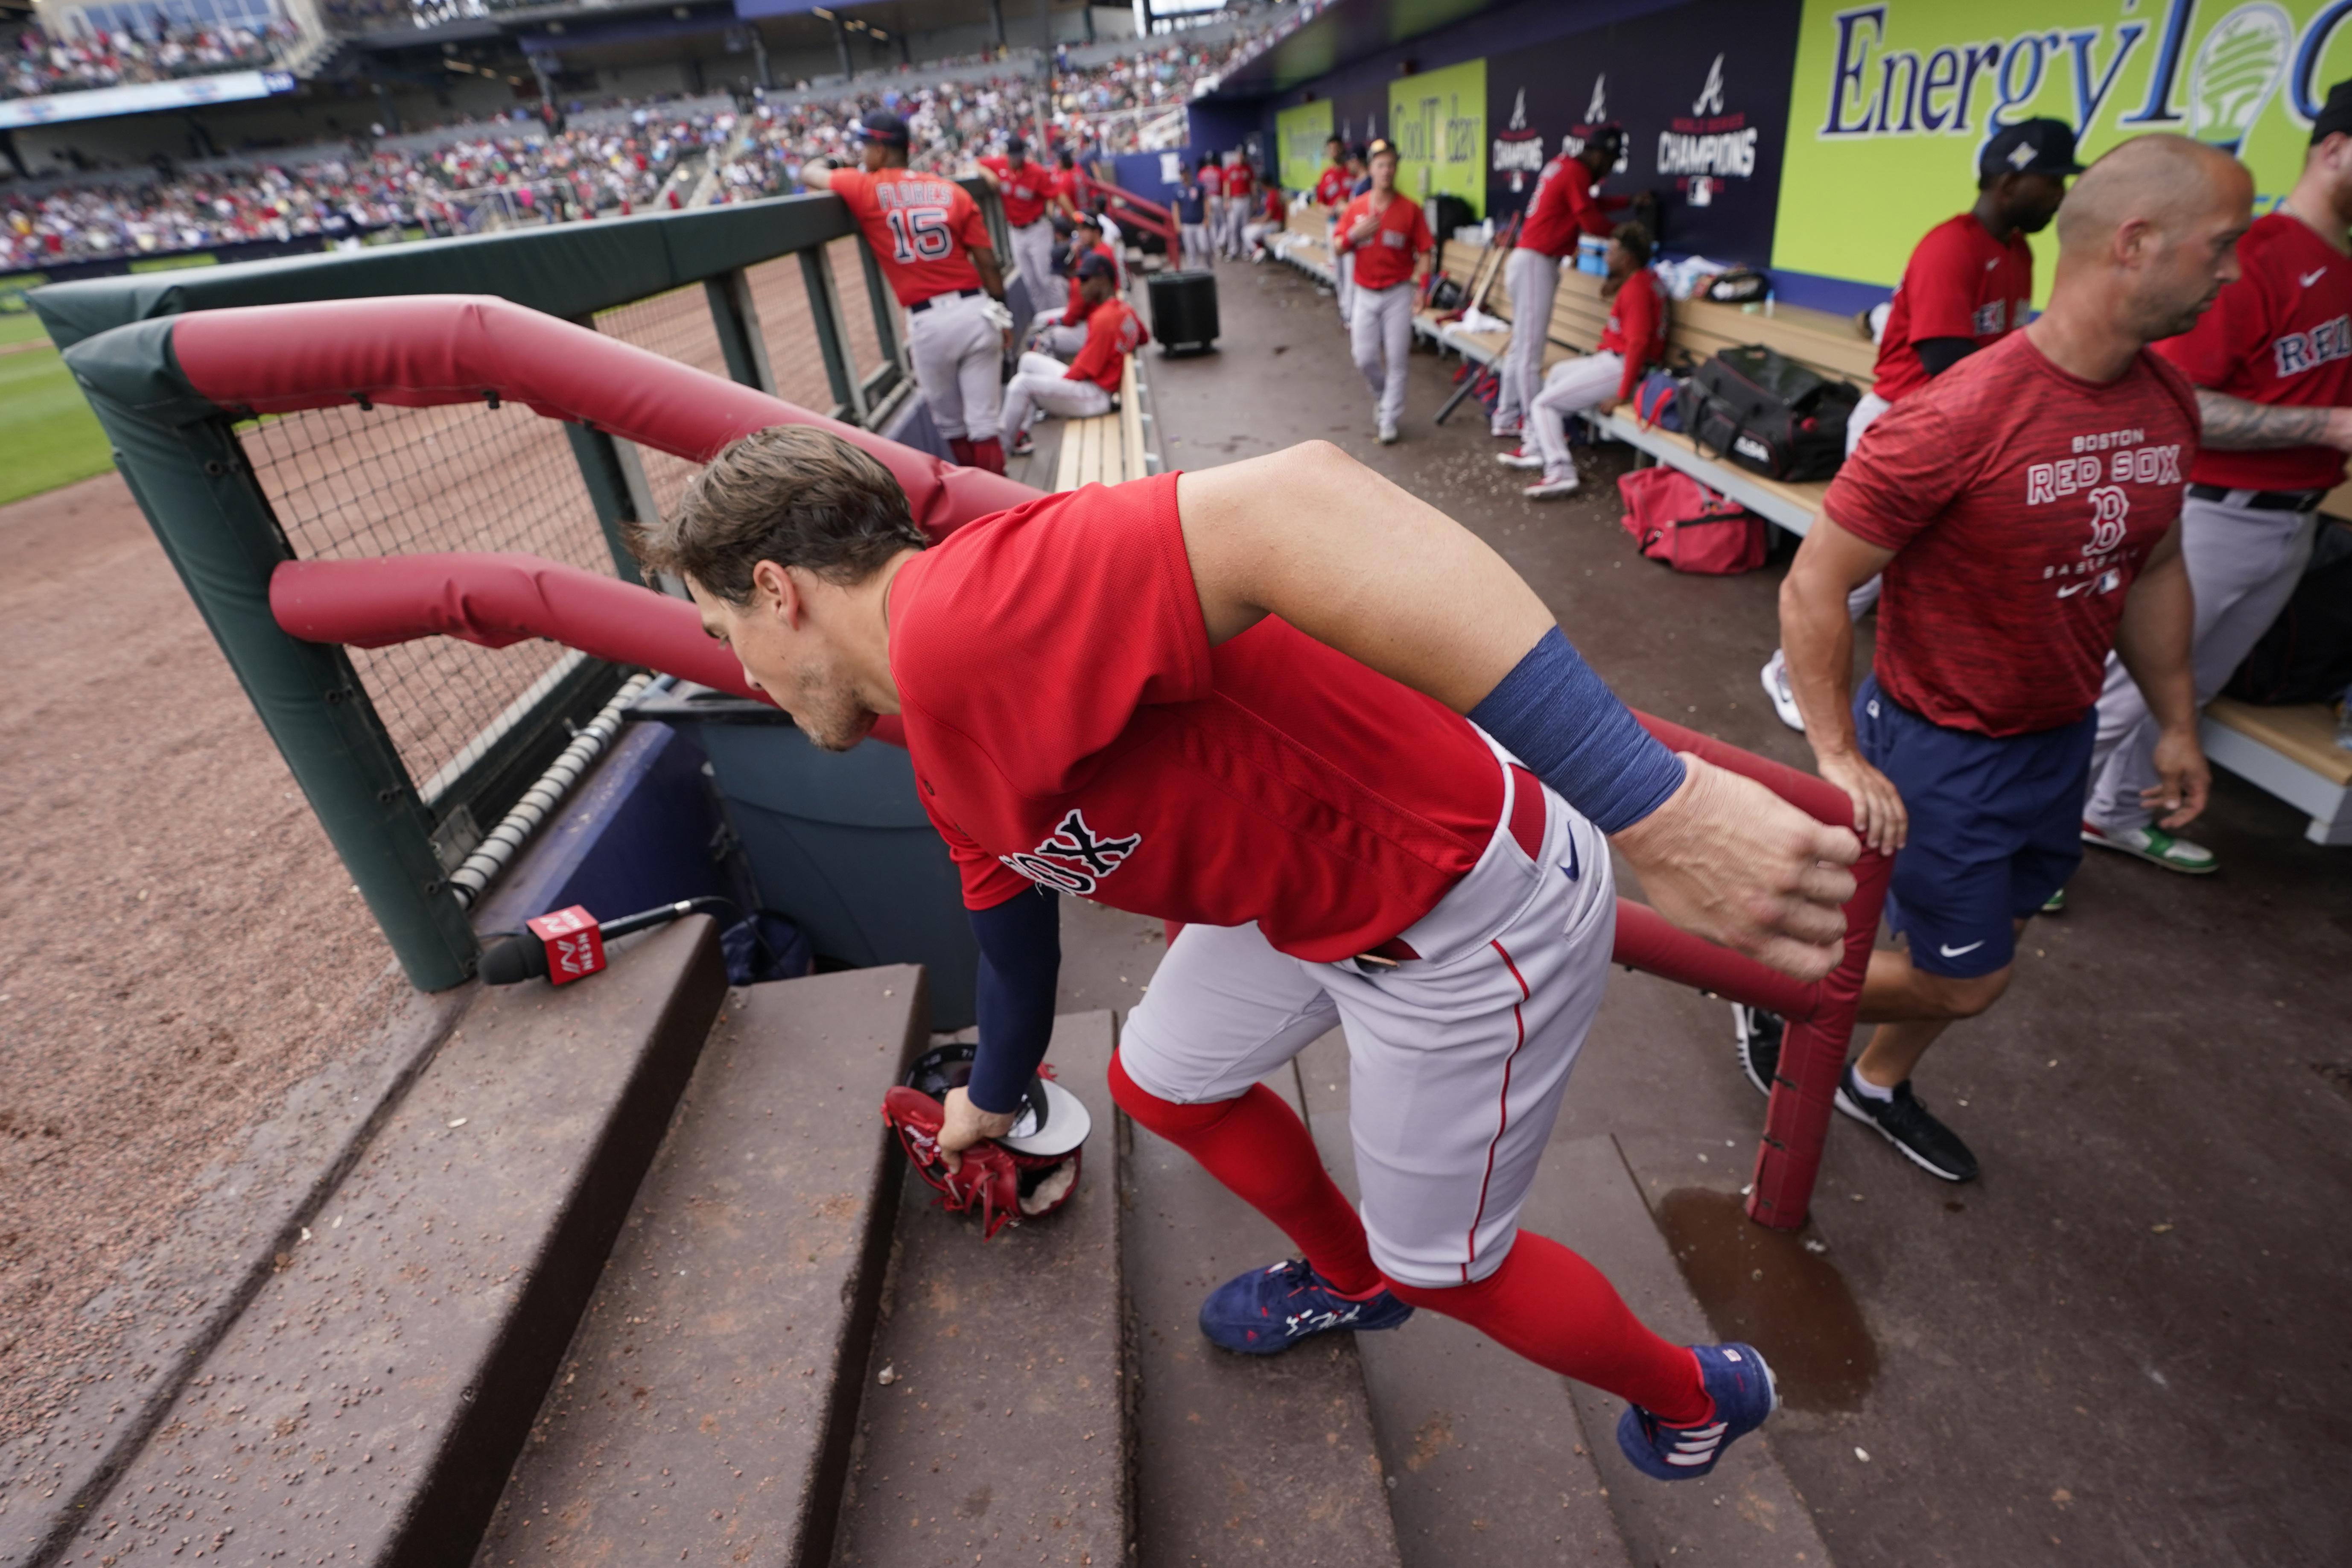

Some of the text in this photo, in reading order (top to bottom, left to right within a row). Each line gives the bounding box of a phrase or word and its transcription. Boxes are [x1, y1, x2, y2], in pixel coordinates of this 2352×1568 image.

[1657, 127, 1758, 178] CHAMPIONS
[876, 180, 953, 212] FLORES
[886, 207, 953, 265] 15
[2072, 428, 2145, 453] BOSTON
[2027, 444, 2181, 505] RED SOX
[2081, 485, 2130, 556] B
[577, 932, 595, 971] NESN
